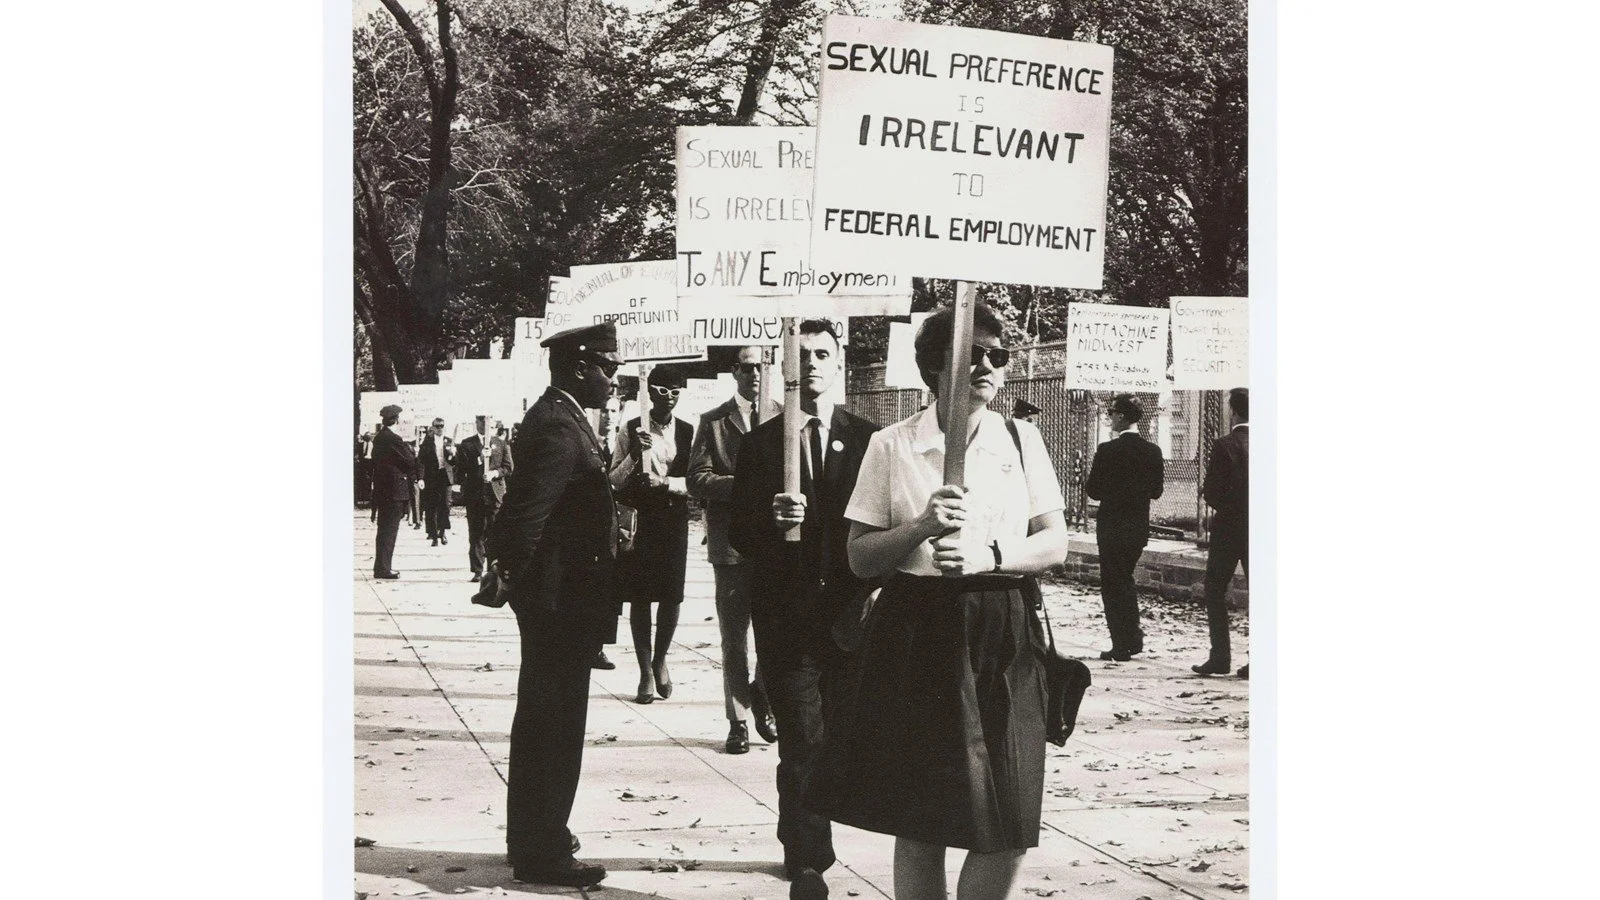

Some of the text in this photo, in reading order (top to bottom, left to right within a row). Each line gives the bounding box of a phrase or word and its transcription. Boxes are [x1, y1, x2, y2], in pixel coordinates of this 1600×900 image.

[826, 42, 1104, 95] SEXUAL PREFERENCE
[957, 95, 984, 113] IS
[859, 115, 1084, 163] IRRELEVANT
[953, 173, 984, 197] TO
[689, 196, 710, 220] IS
[825, 208, 1096, 252] FEDERAL EMPLOYMENT
[711, 251, 751, 286] ANY
[574, 270, 618, 304] DENIAL
[620, 265, 634, 279] OF
[629, 297, 647, 308] OF
[593, 309, 679, 327] OPPORTUNITY
[1072, 322, 1159, 340] MATTACHINE
[1077, 338, 1144, 353] MIDWEST
